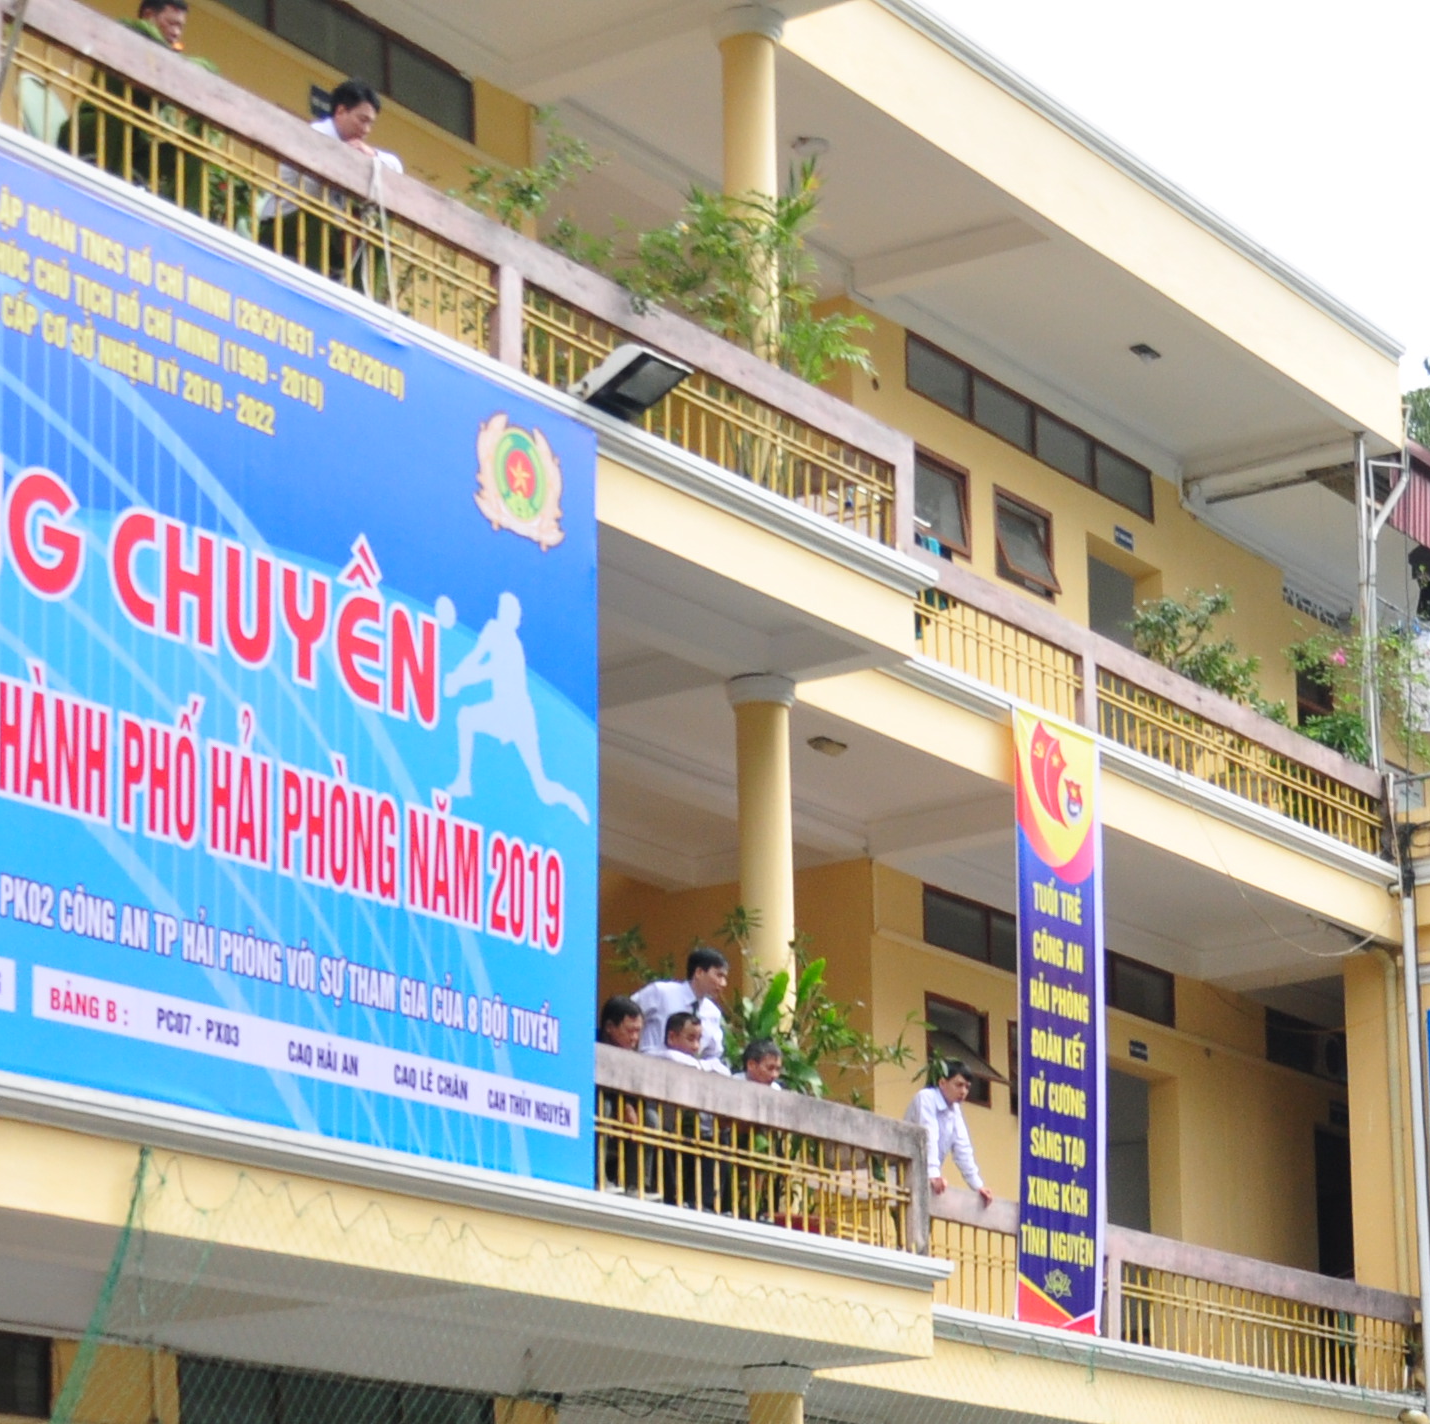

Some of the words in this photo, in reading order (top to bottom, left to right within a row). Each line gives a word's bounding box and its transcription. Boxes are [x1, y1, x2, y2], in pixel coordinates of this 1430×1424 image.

[182, 370, 223, 414] 2019
[237, 392, 275, 436] 2022
[280, 365, 324, 412] 2019)
[109, 535, 441, 729] CHUYỀN
[120, 697, 203, 848] PHỐ
[209, 710, 271, 870] HẢI
[278, 754, 399, 909] PHÒNG
[406, 791, 484, 929] NĂM
[489, 836, 564, 954] 2019
[1060, 887, 1082, 926] TRẺ
[0, 873, 54, 928] PK02
[59, 884, 115, 943] CÔNG
[121, 903, 150, 950] AN
[154, 912, 177, 956] TP
[182, 906, 216, 968] HẢI
[220, 926, 282, 985] PHÒNG
[286, 938, 316, 993] VỚI
[320, 955, 346, 1007] SỰ
[348, 962, 396, 1013] THAM
[400, 974, 428, 1021] GIA
[432, 972, 464, 1031] CỦA
[468, 995, 478, 1034] 8
[481, 994, 508, 1048] ĐỘI
[1033, 927, 1064, 968] CÔNG
[1066, 942, 1083, 974] AN
[50, 980, 100, 1019] BẢNG
[106, 1000, 116, 1023] B
[1030, 971, 1049, 1012] HẢI
[1051, 984, 1089, 1024] PHÒNG
[157, 1006, 192, 1036] PC07
[206, 1018, 240, 1047] PX03
[1031, 1026, 1062, 1065] ĐOÀN
[1064, 1032, 1086, 1070] KẾT
[288, 1040, 312, 1067] CAQ
[342, 1055, 359, 1077] AN
[394, 1064, 417, 1090] CAQ
[420, 1067, 433, 1093] LÊ
[487, 1088, 506, 1110] CAH
[1030, 1123, 1062, 1163] SÁNG
[1064, 1134, 1086, 1172] TẠO
[1027, 1175, 1059, 1210] XUNG
[1062, 1179, 1088, 1218] KÍCH
[1021, 1218, 1048, 1258] TÌNH
[1050, 1230, 1094, 1272] NGUYỆN
